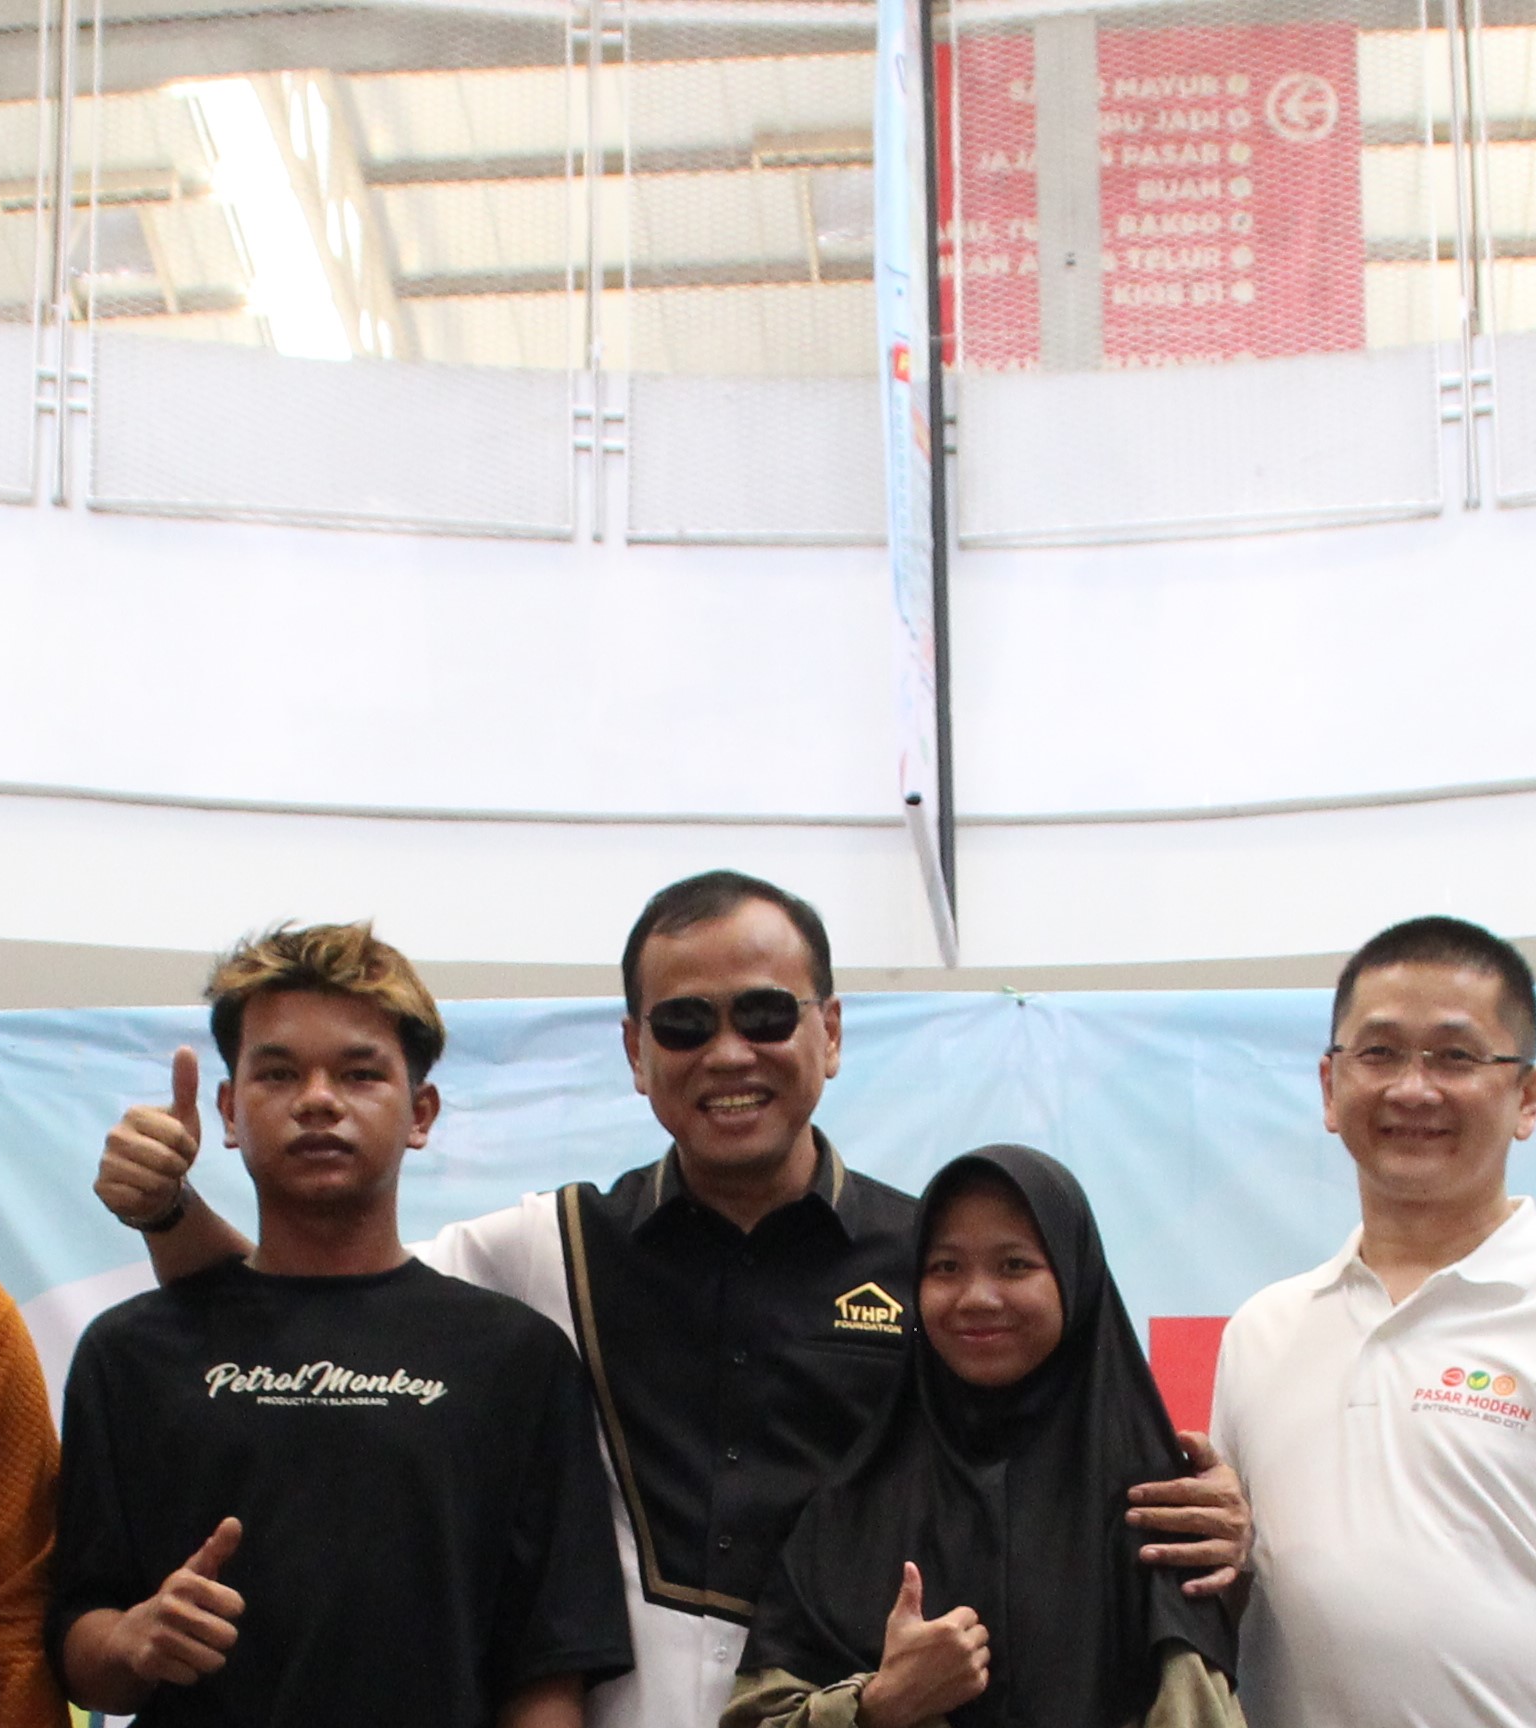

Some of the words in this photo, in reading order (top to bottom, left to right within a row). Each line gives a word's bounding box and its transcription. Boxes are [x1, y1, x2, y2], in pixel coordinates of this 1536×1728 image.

[1116, 75, 1219, 99] MAYUR
[1121, 142, 1221, 168] PASAR
[1138, 178, 1222, 203] BUAH
[849, 1304, 889, 1322] YHP
[834, 1319, 903, 1335] FOUNDATION
[205, 1362, 312, 1398] Petrol
[307, 1360, 448, 1405] Monkey
[1414, 1388, 1463, 1404] PASAR
[1465, 1394, 1533, 1421] MODERN
